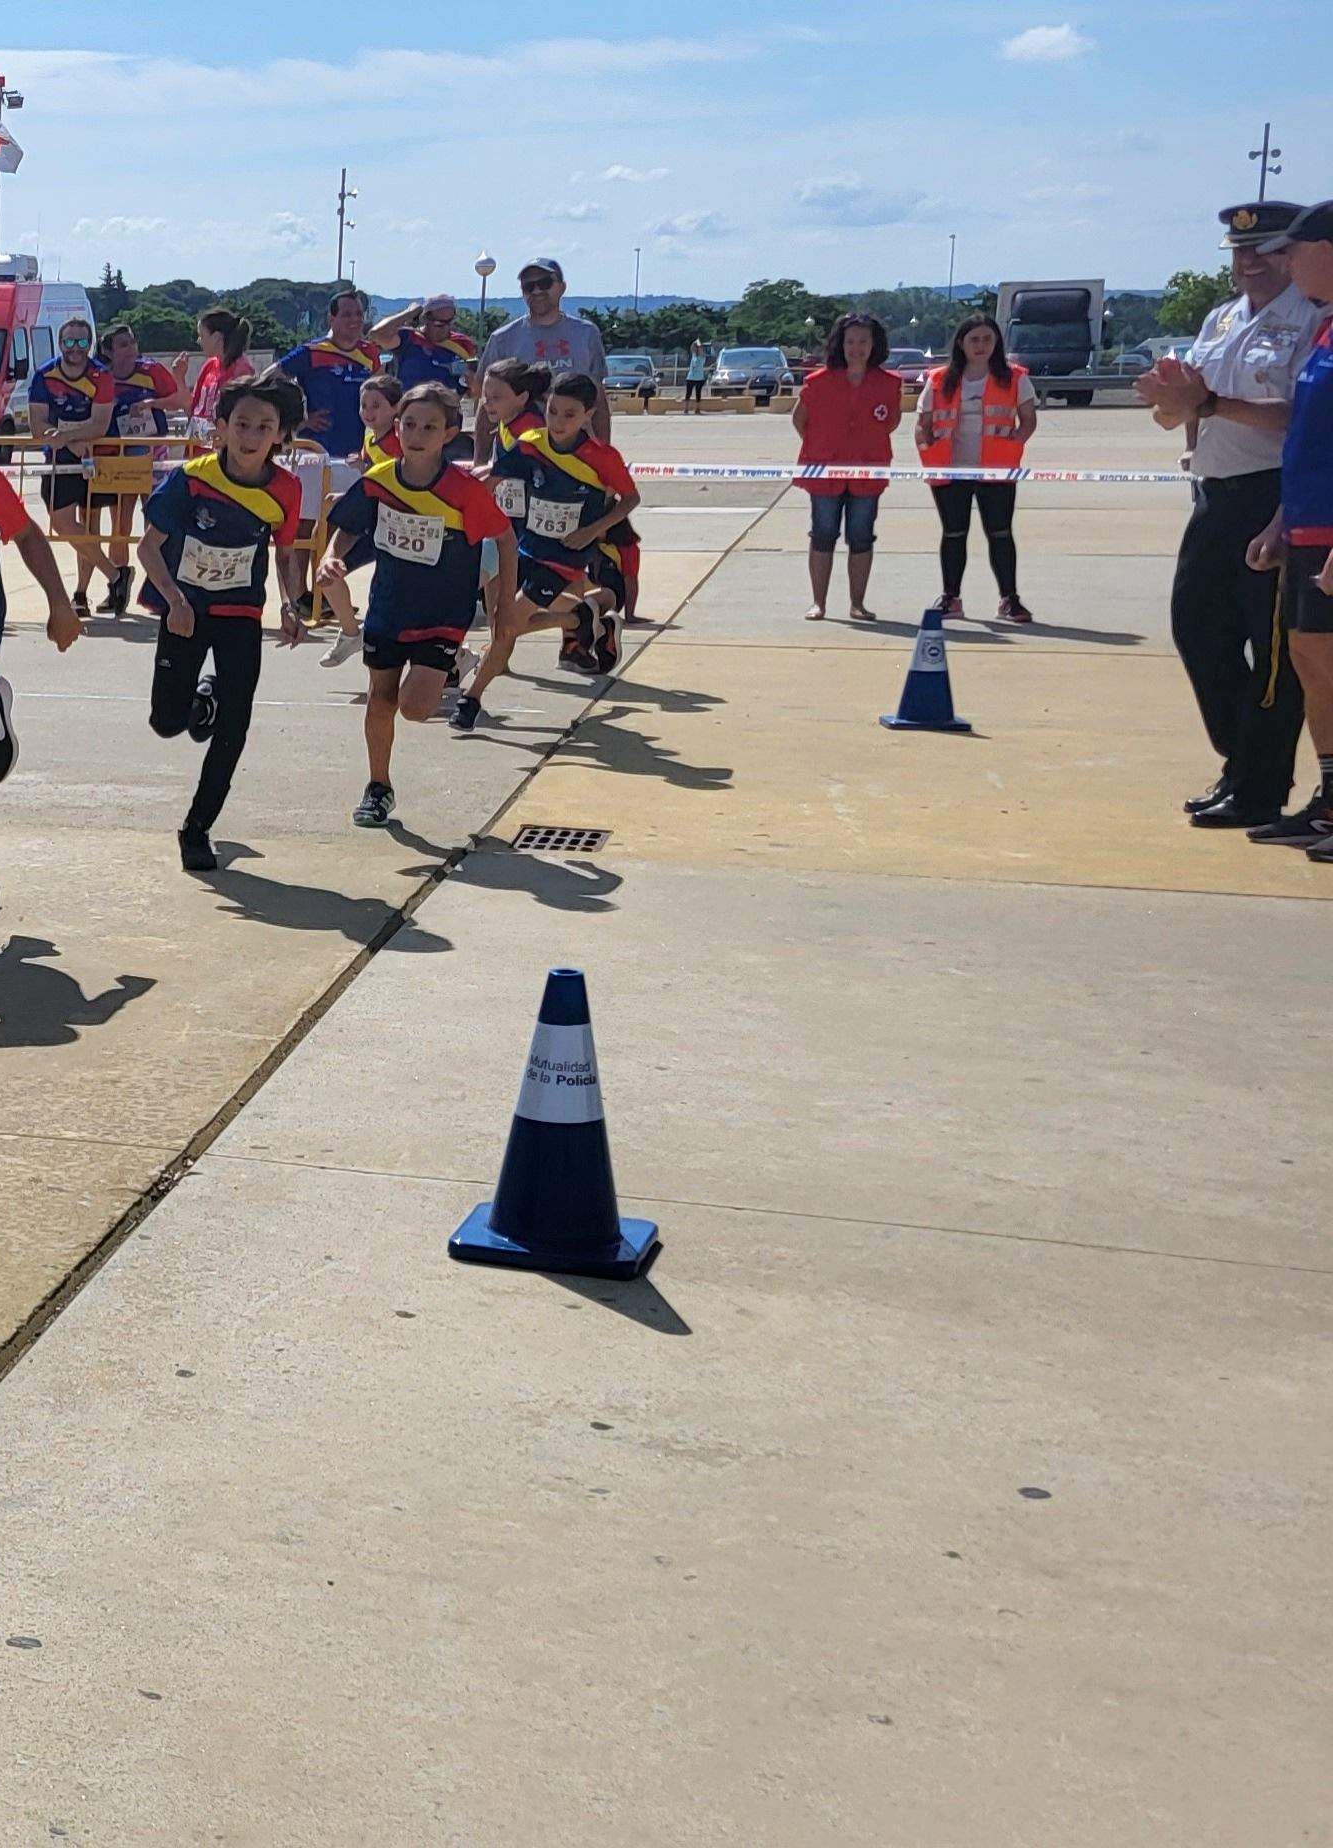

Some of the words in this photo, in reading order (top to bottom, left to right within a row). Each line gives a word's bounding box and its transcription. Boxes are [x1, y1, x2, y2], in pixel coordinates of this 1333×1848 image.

[535, 518, 567, 533] 763
[530, 1055, 591, 1073] Mutualidad
[527, 1068, 538, 1080] de
[540, 1070, 551, 1083] la
